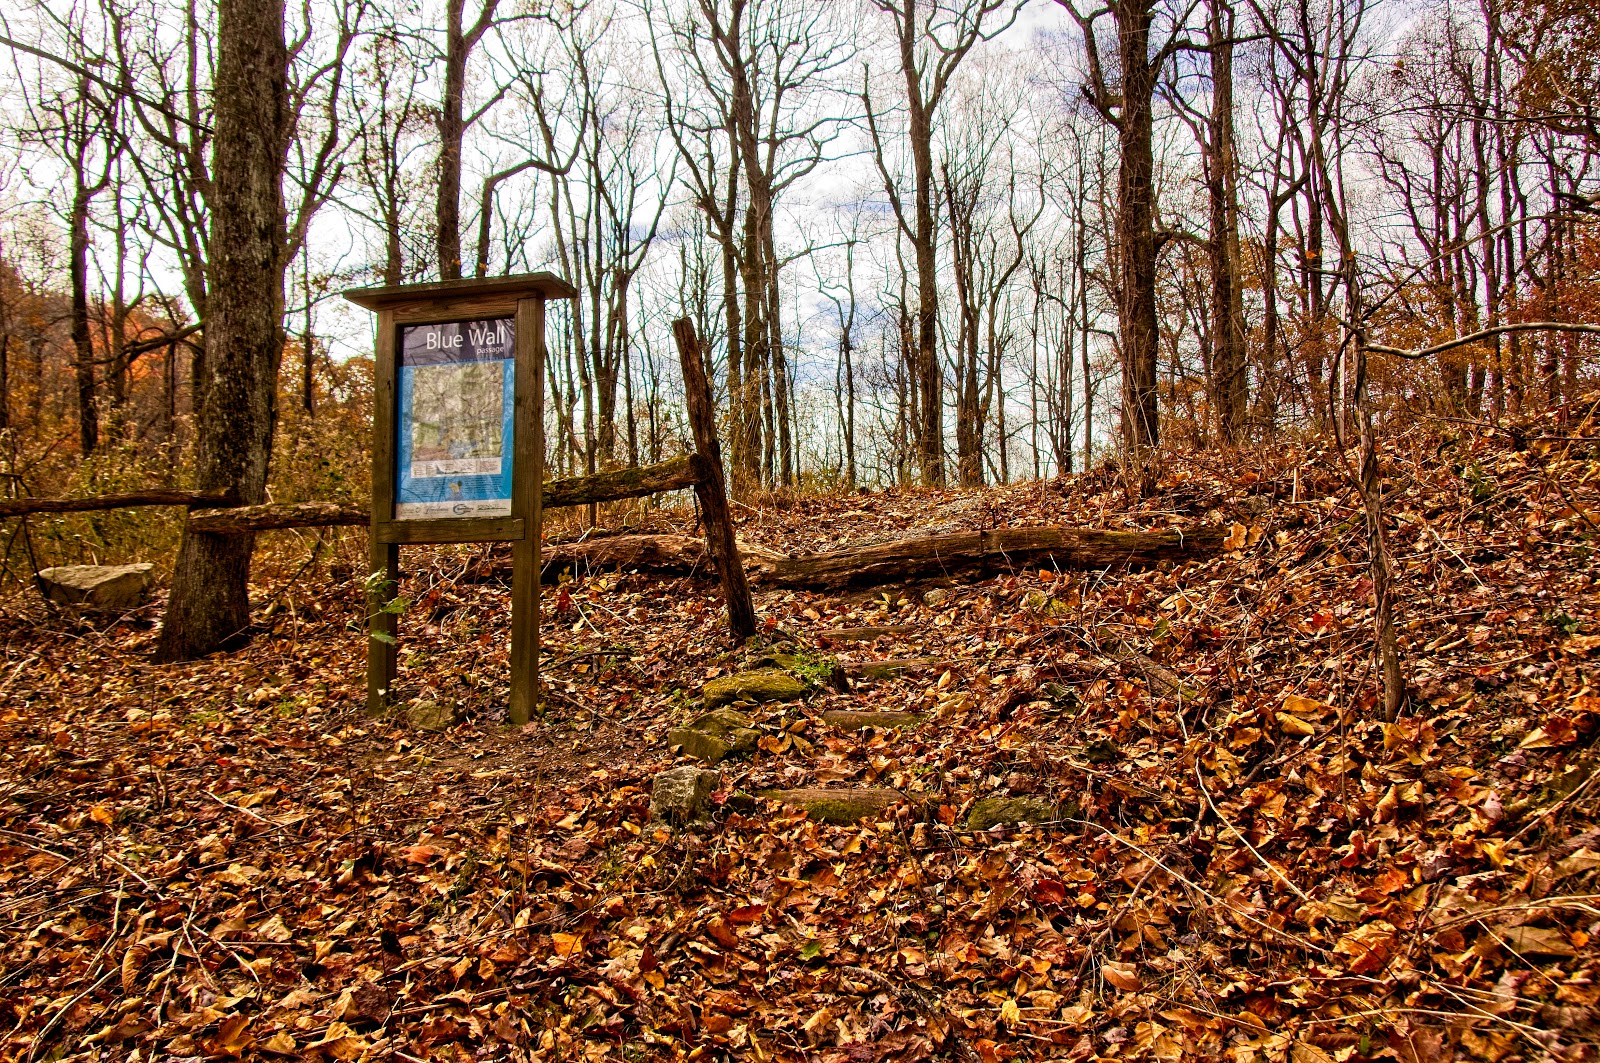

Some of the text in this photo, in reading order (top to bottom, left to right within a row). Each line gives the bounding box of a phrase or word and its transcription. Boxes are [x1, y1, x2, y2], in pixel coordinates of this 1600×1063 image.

[426, 325, 504, 349] Blue Wall
[476, 346, 504, 355] passage
